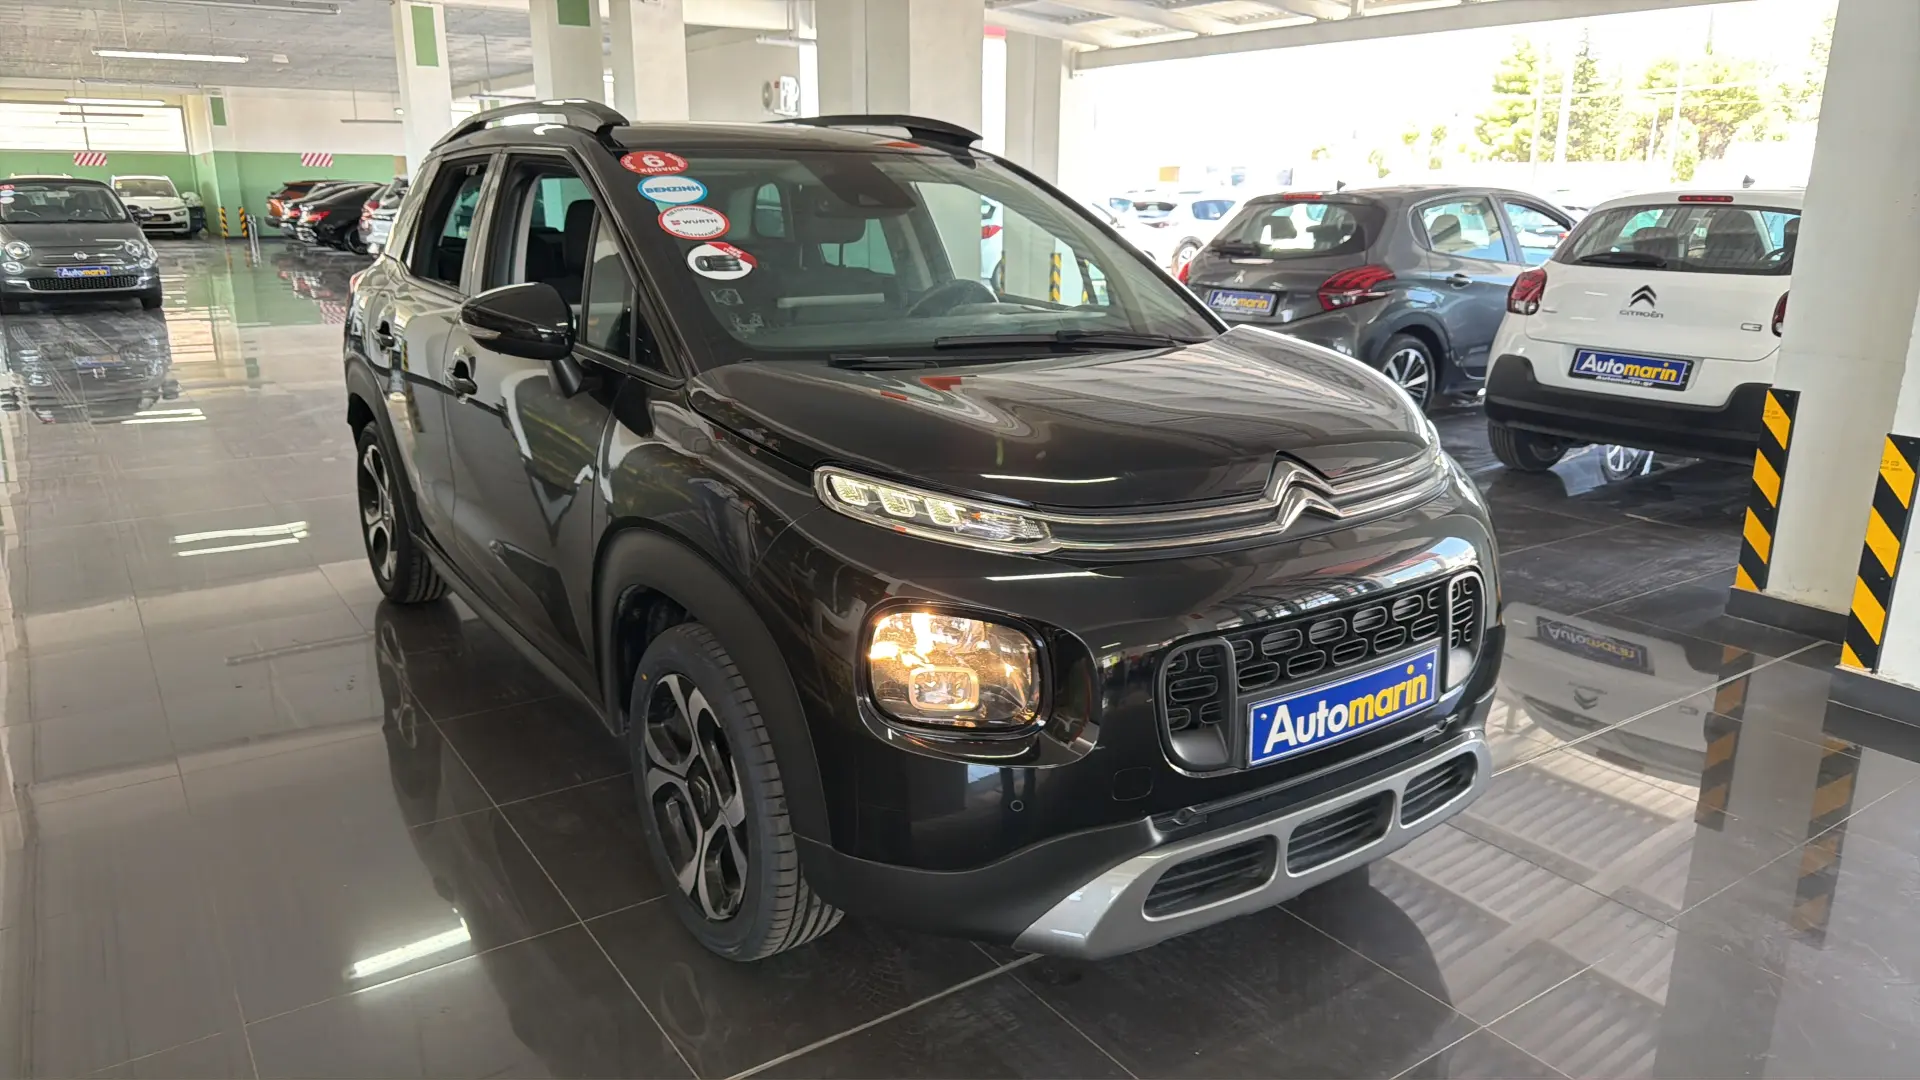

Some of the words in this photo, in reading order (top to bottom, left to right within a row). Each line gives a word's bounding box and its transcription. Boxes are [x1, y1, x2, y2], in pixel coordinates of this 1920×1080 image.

[1212, 291, 1268, 310] Automarin
[1740, 322, 1762, 332] C3
[1580, 353, 1677, 382] Automarin
[1263, 664, 1427, 754] Automarin
